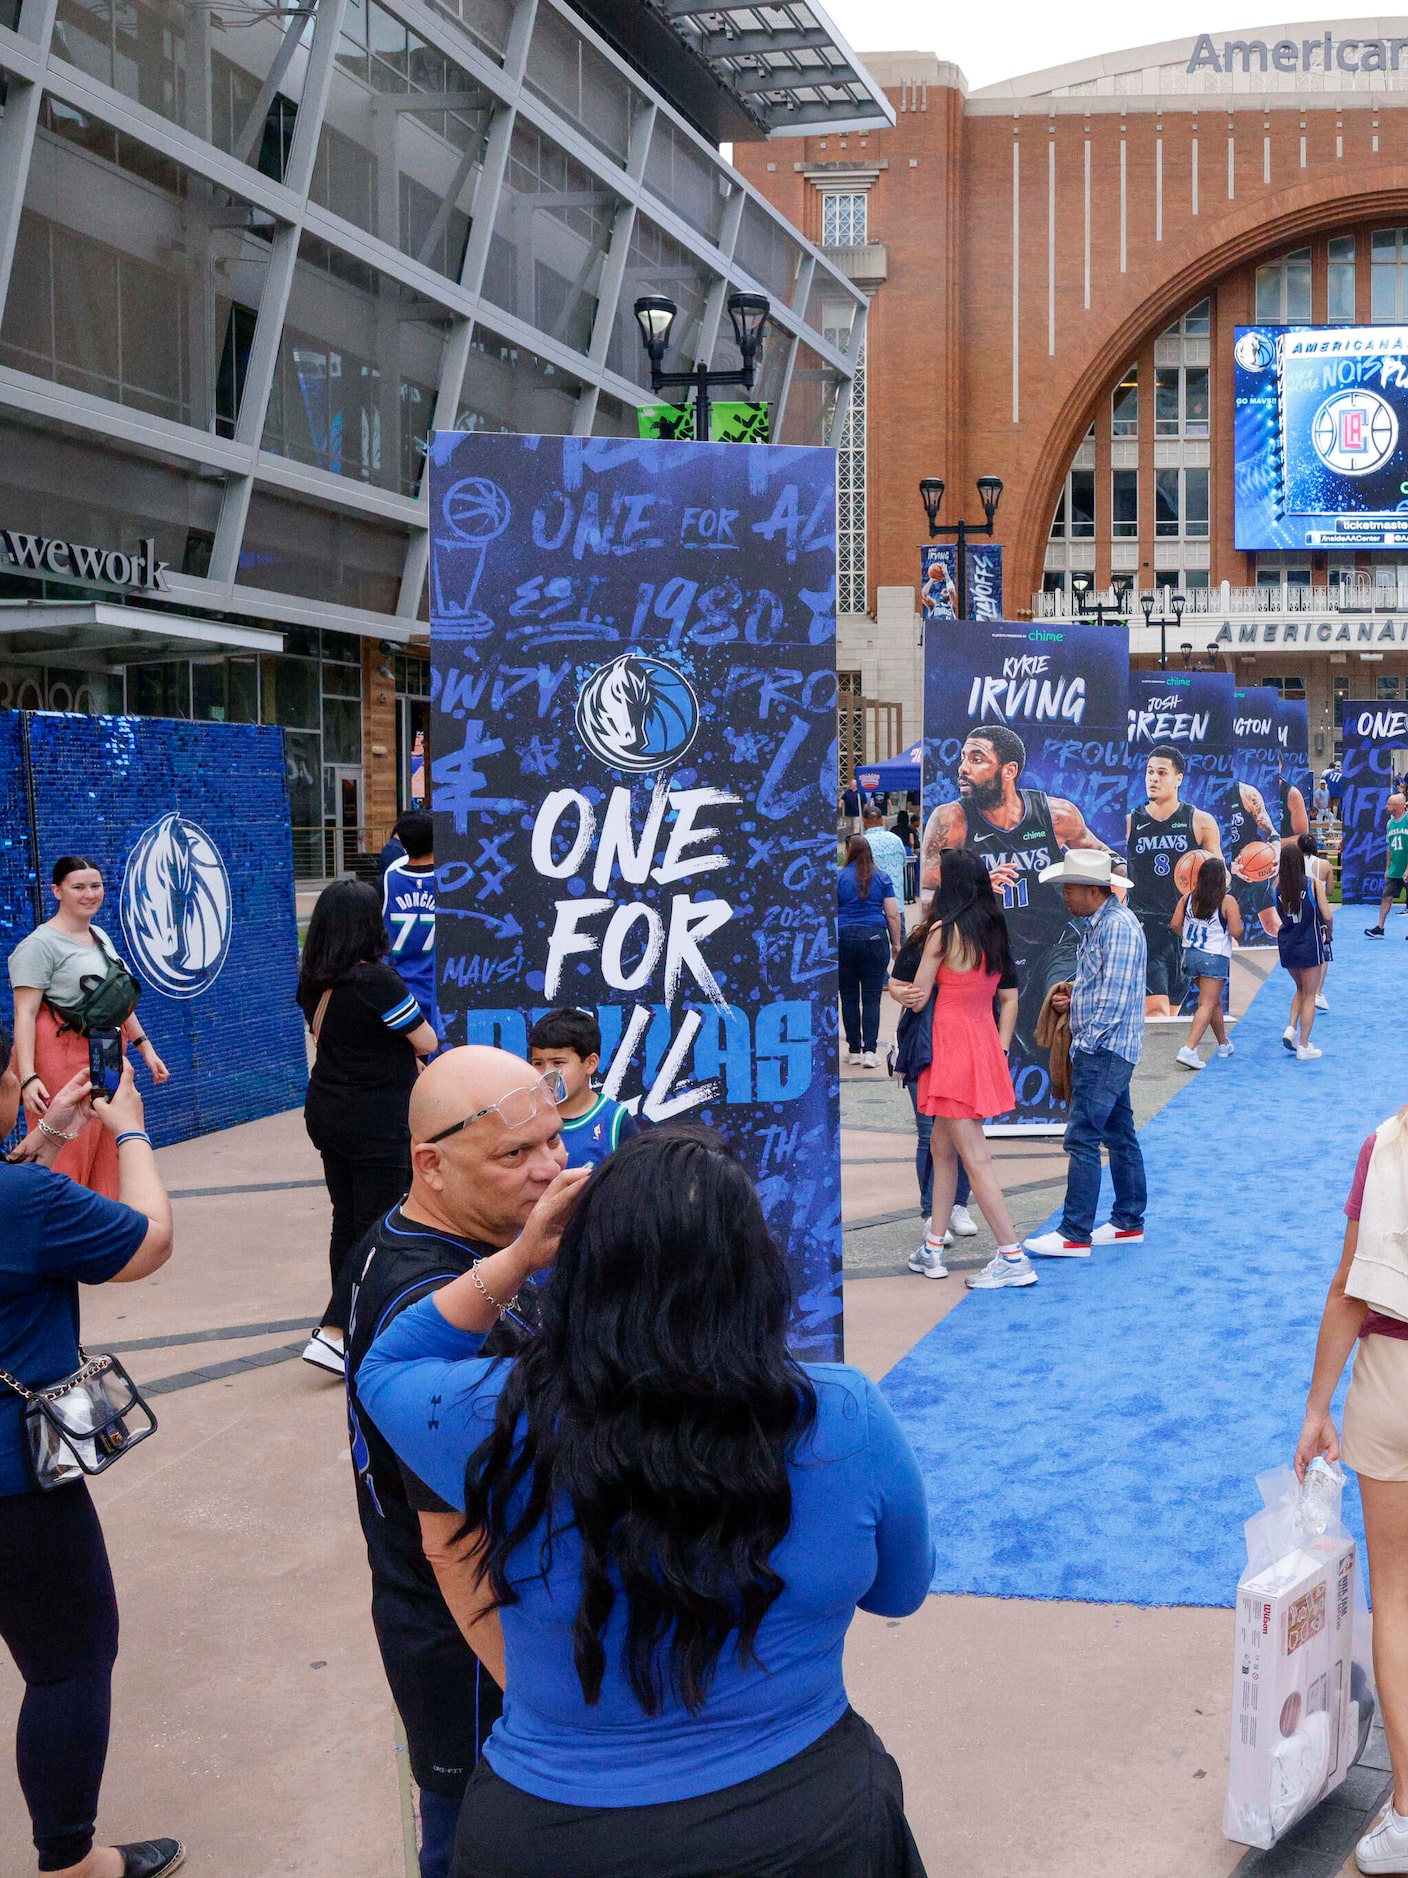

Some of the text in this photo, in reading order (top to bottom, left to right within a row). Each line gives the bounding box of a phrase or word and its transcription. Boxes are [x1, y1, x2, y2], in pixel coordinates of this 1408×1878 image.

[6, 529, 171, 593] wework
[1028, 629, 1064, 642] chime
[1003, 654, 1051, 679] KYRIE
[1166, 677, 1192, 687] chime
[967, 676, 1087, 726] IRVING
[1148, 694, 1183, 711] JOSH
[1357, 708, 1406, 740] ONE
[531, 770, 743, 893] ONE
[1022, 830, 1047, 841] chime
[1135, 833, 1189, 854] MAVS
[1389, 836, 1404, 851] 41
[1153, 853, 1171, 877] 8
[390, 913, 435, 956] 77
[543, 894, 735, 1020] FOR
[1262, 1603, 1271, 1635] Wilson
